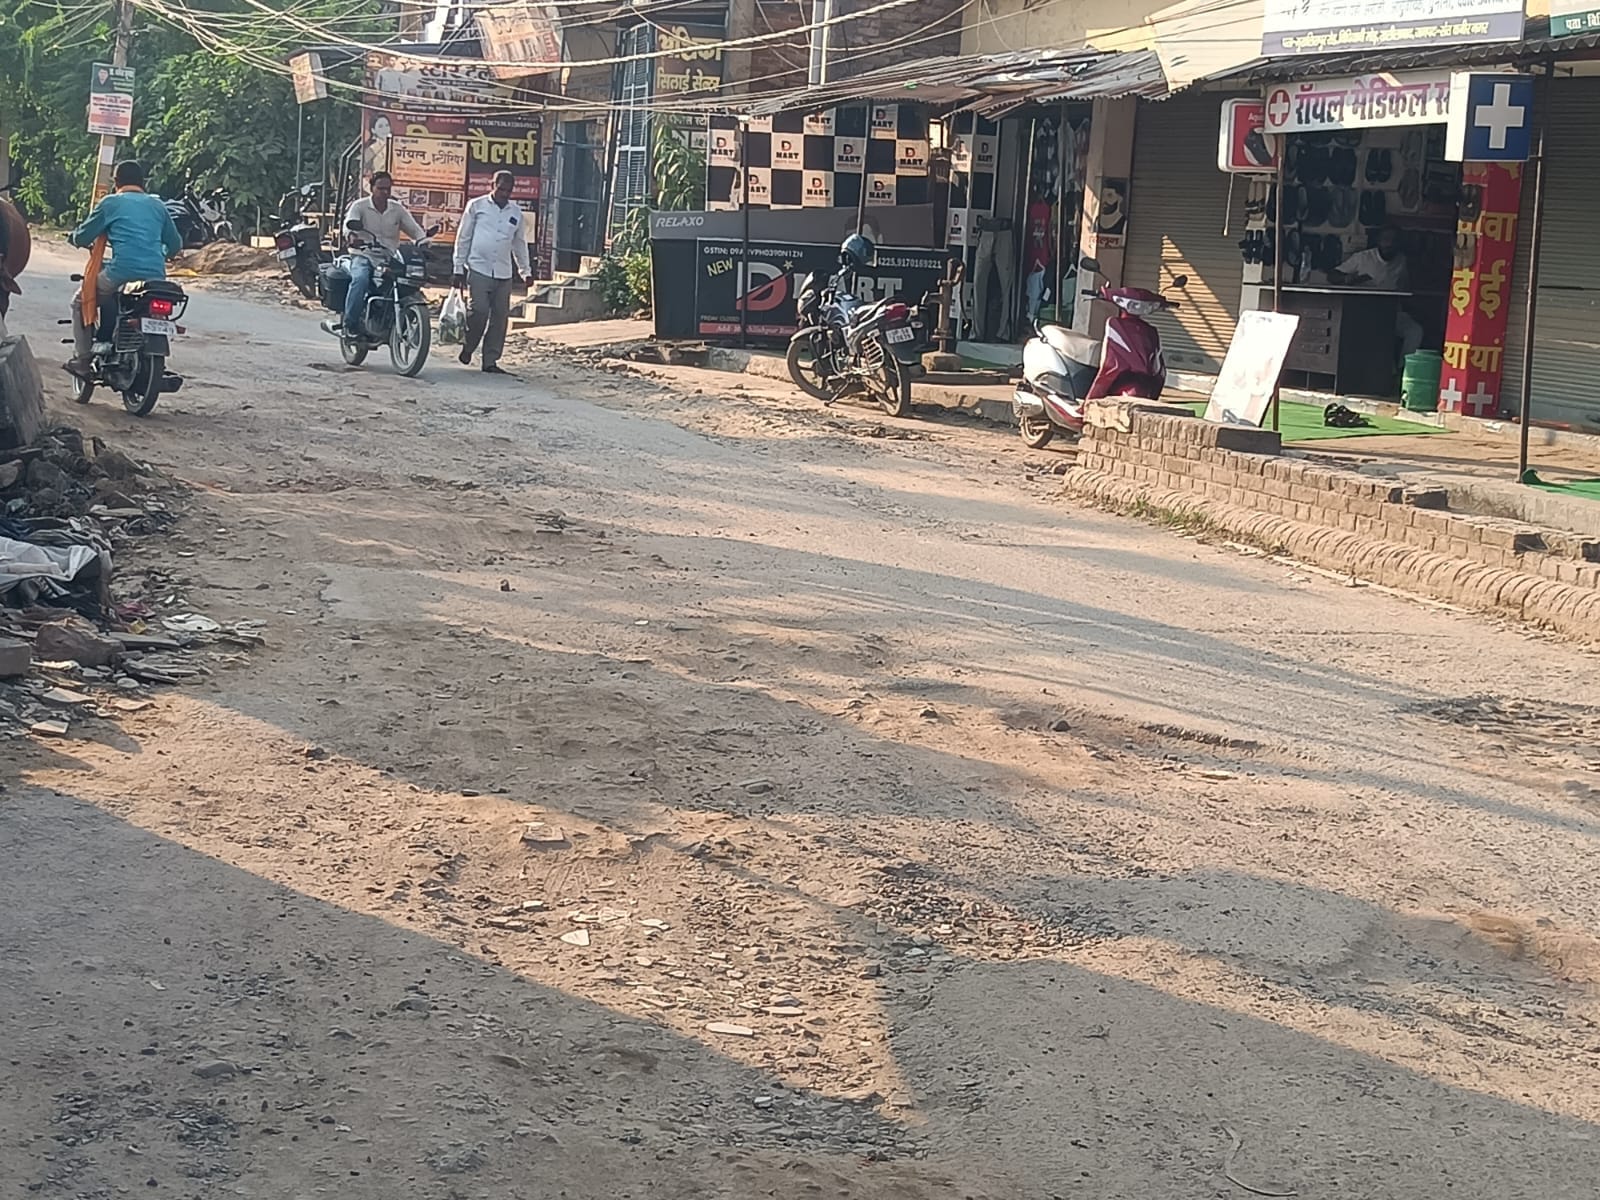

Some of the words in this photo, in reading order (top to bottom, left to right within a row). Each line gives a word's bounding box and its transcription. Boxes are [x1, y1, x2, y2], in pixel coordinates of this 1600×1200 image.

[1294, 83, 1348, 126] रॉयल
[1350, 74, 1432, 120] मेडिकल
[655, 216, 705, 228] RELAXO
[703, 246, 728, 255] GSTIN:
[706, 256, 734, 278] NEW
